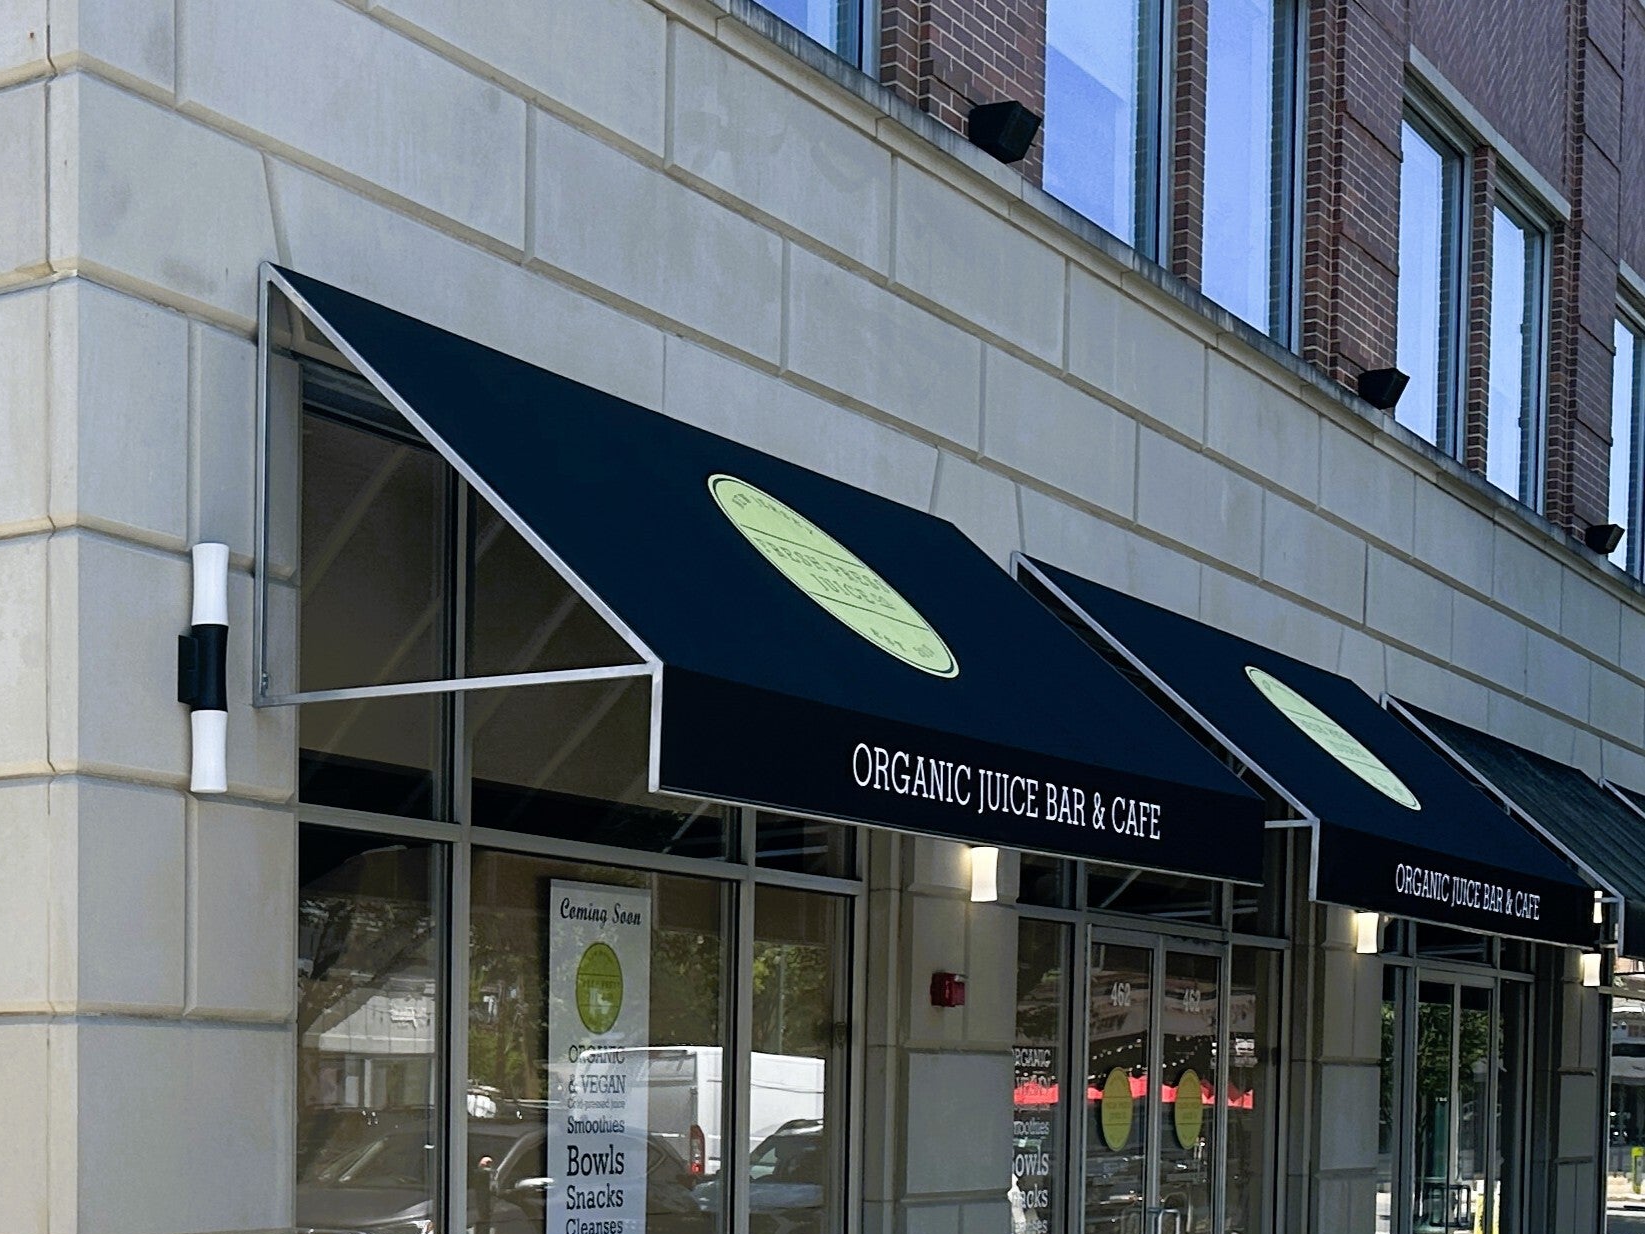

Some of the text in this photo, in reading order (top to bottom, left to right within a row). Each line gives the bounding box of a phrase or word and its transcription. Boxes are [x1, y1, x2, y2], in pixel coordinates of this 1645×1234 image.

[852, 742, 1162, 840] ORGANIC JUICE BAR & CAFE
[1395, 863, 1541, 921] ORGANIC JUICE BAR & CAFE
[559, 896, 642, 929] Coming Soon
[1110, 981, 1132, 1007] 462
[1182, 988, 1202, 1013] 462
[568, 1044, 626, 1065] ORGANIC
[1012, 1047, 1052, 1069] RGANIC
[568, 1073, 627, 1095] & VEGAN
[567, 1115, 626, 1135] Smoothies
[566, 1143, 625, 1177] Bowls
[1012, 1144, 1050, 1178] owls
[566, 1182, 624, 1211] Snacks
